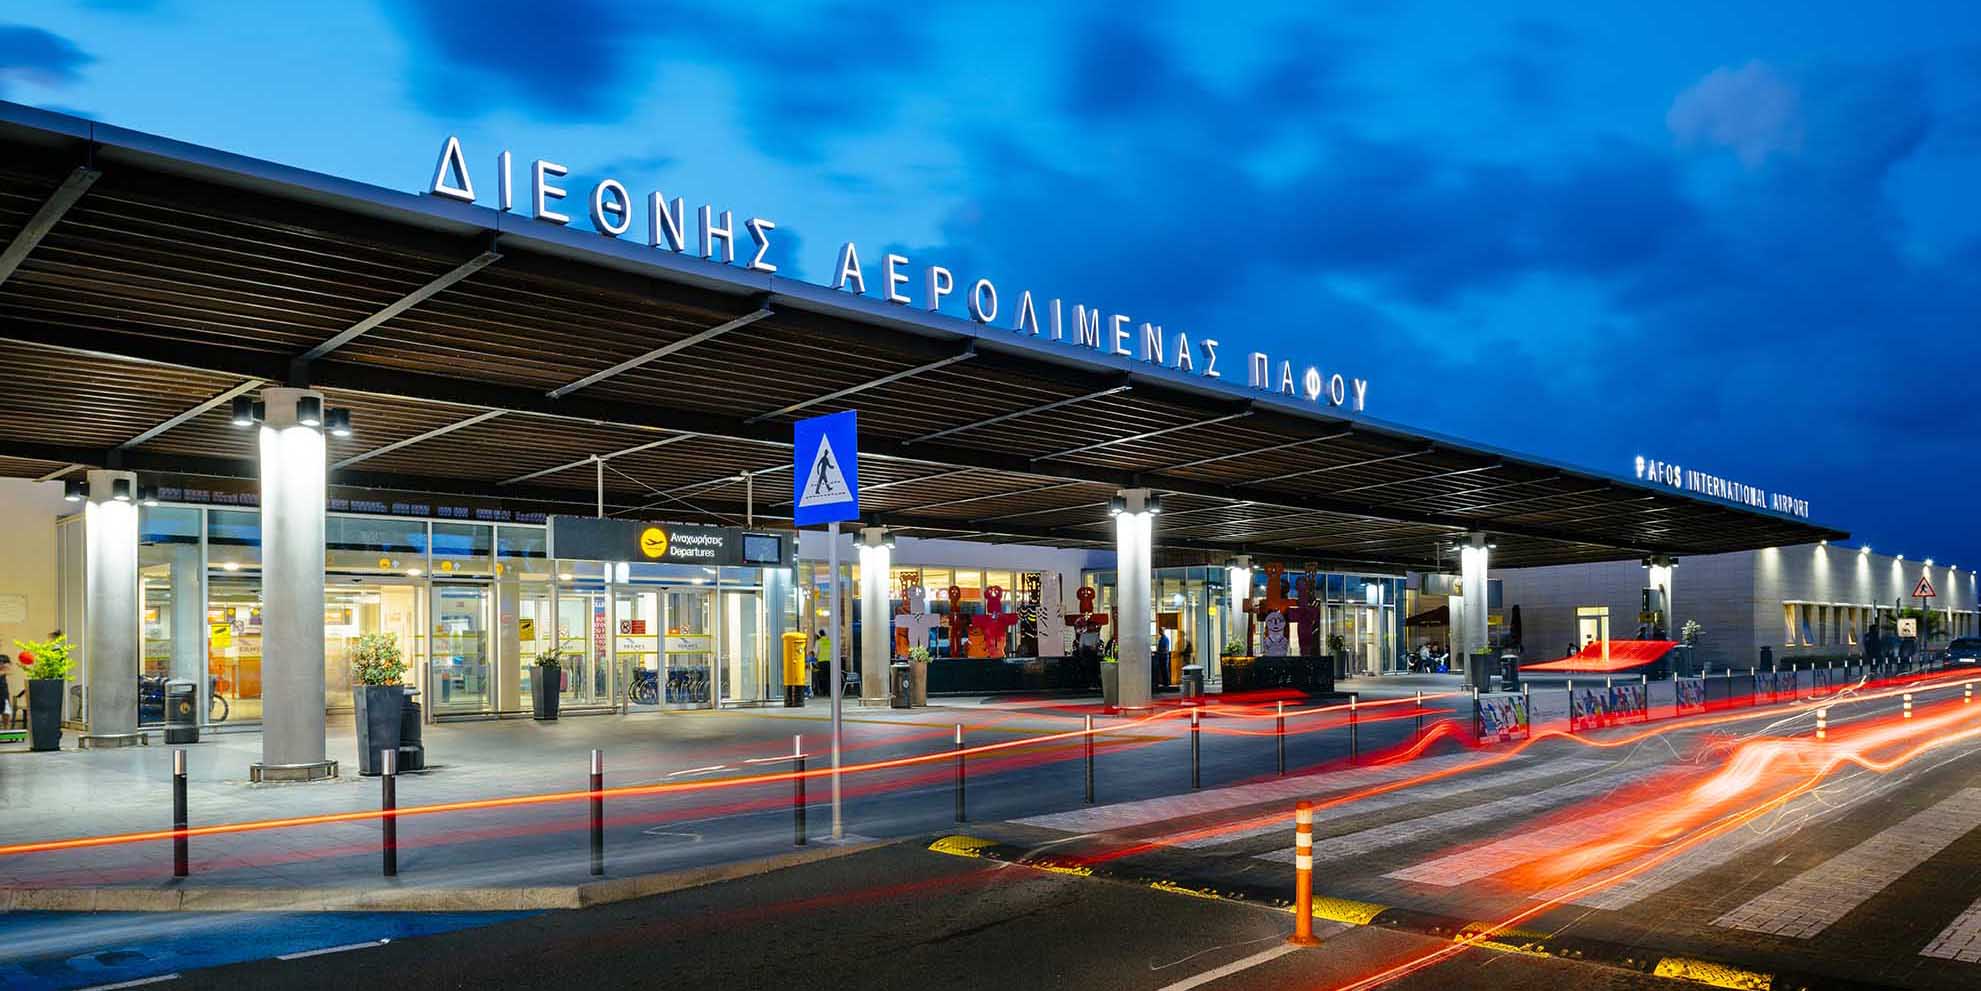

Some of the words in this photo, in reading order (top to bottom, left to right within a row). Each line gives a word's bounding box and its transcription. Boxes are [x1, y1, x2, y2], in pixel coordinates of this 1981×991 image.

[431, 136, 776, 272] ΔΙΕΘΝΗΣ
[832, 242, 1221, 377] ΑΕΡΟΛΙΜΕΝΑΣ
[1248, 352, 1368, 412] ΠΑΦΟΥ
[1635, 455, 1682, 488] PAFOS
[1687, 470, 1768, 509] INTERNATIONAL
[1771, 492, 1809, 518] AIRPORT
[670, 532, 724, 547] Αναχωρήσεις
[670, 546, 715, 559] Departures
